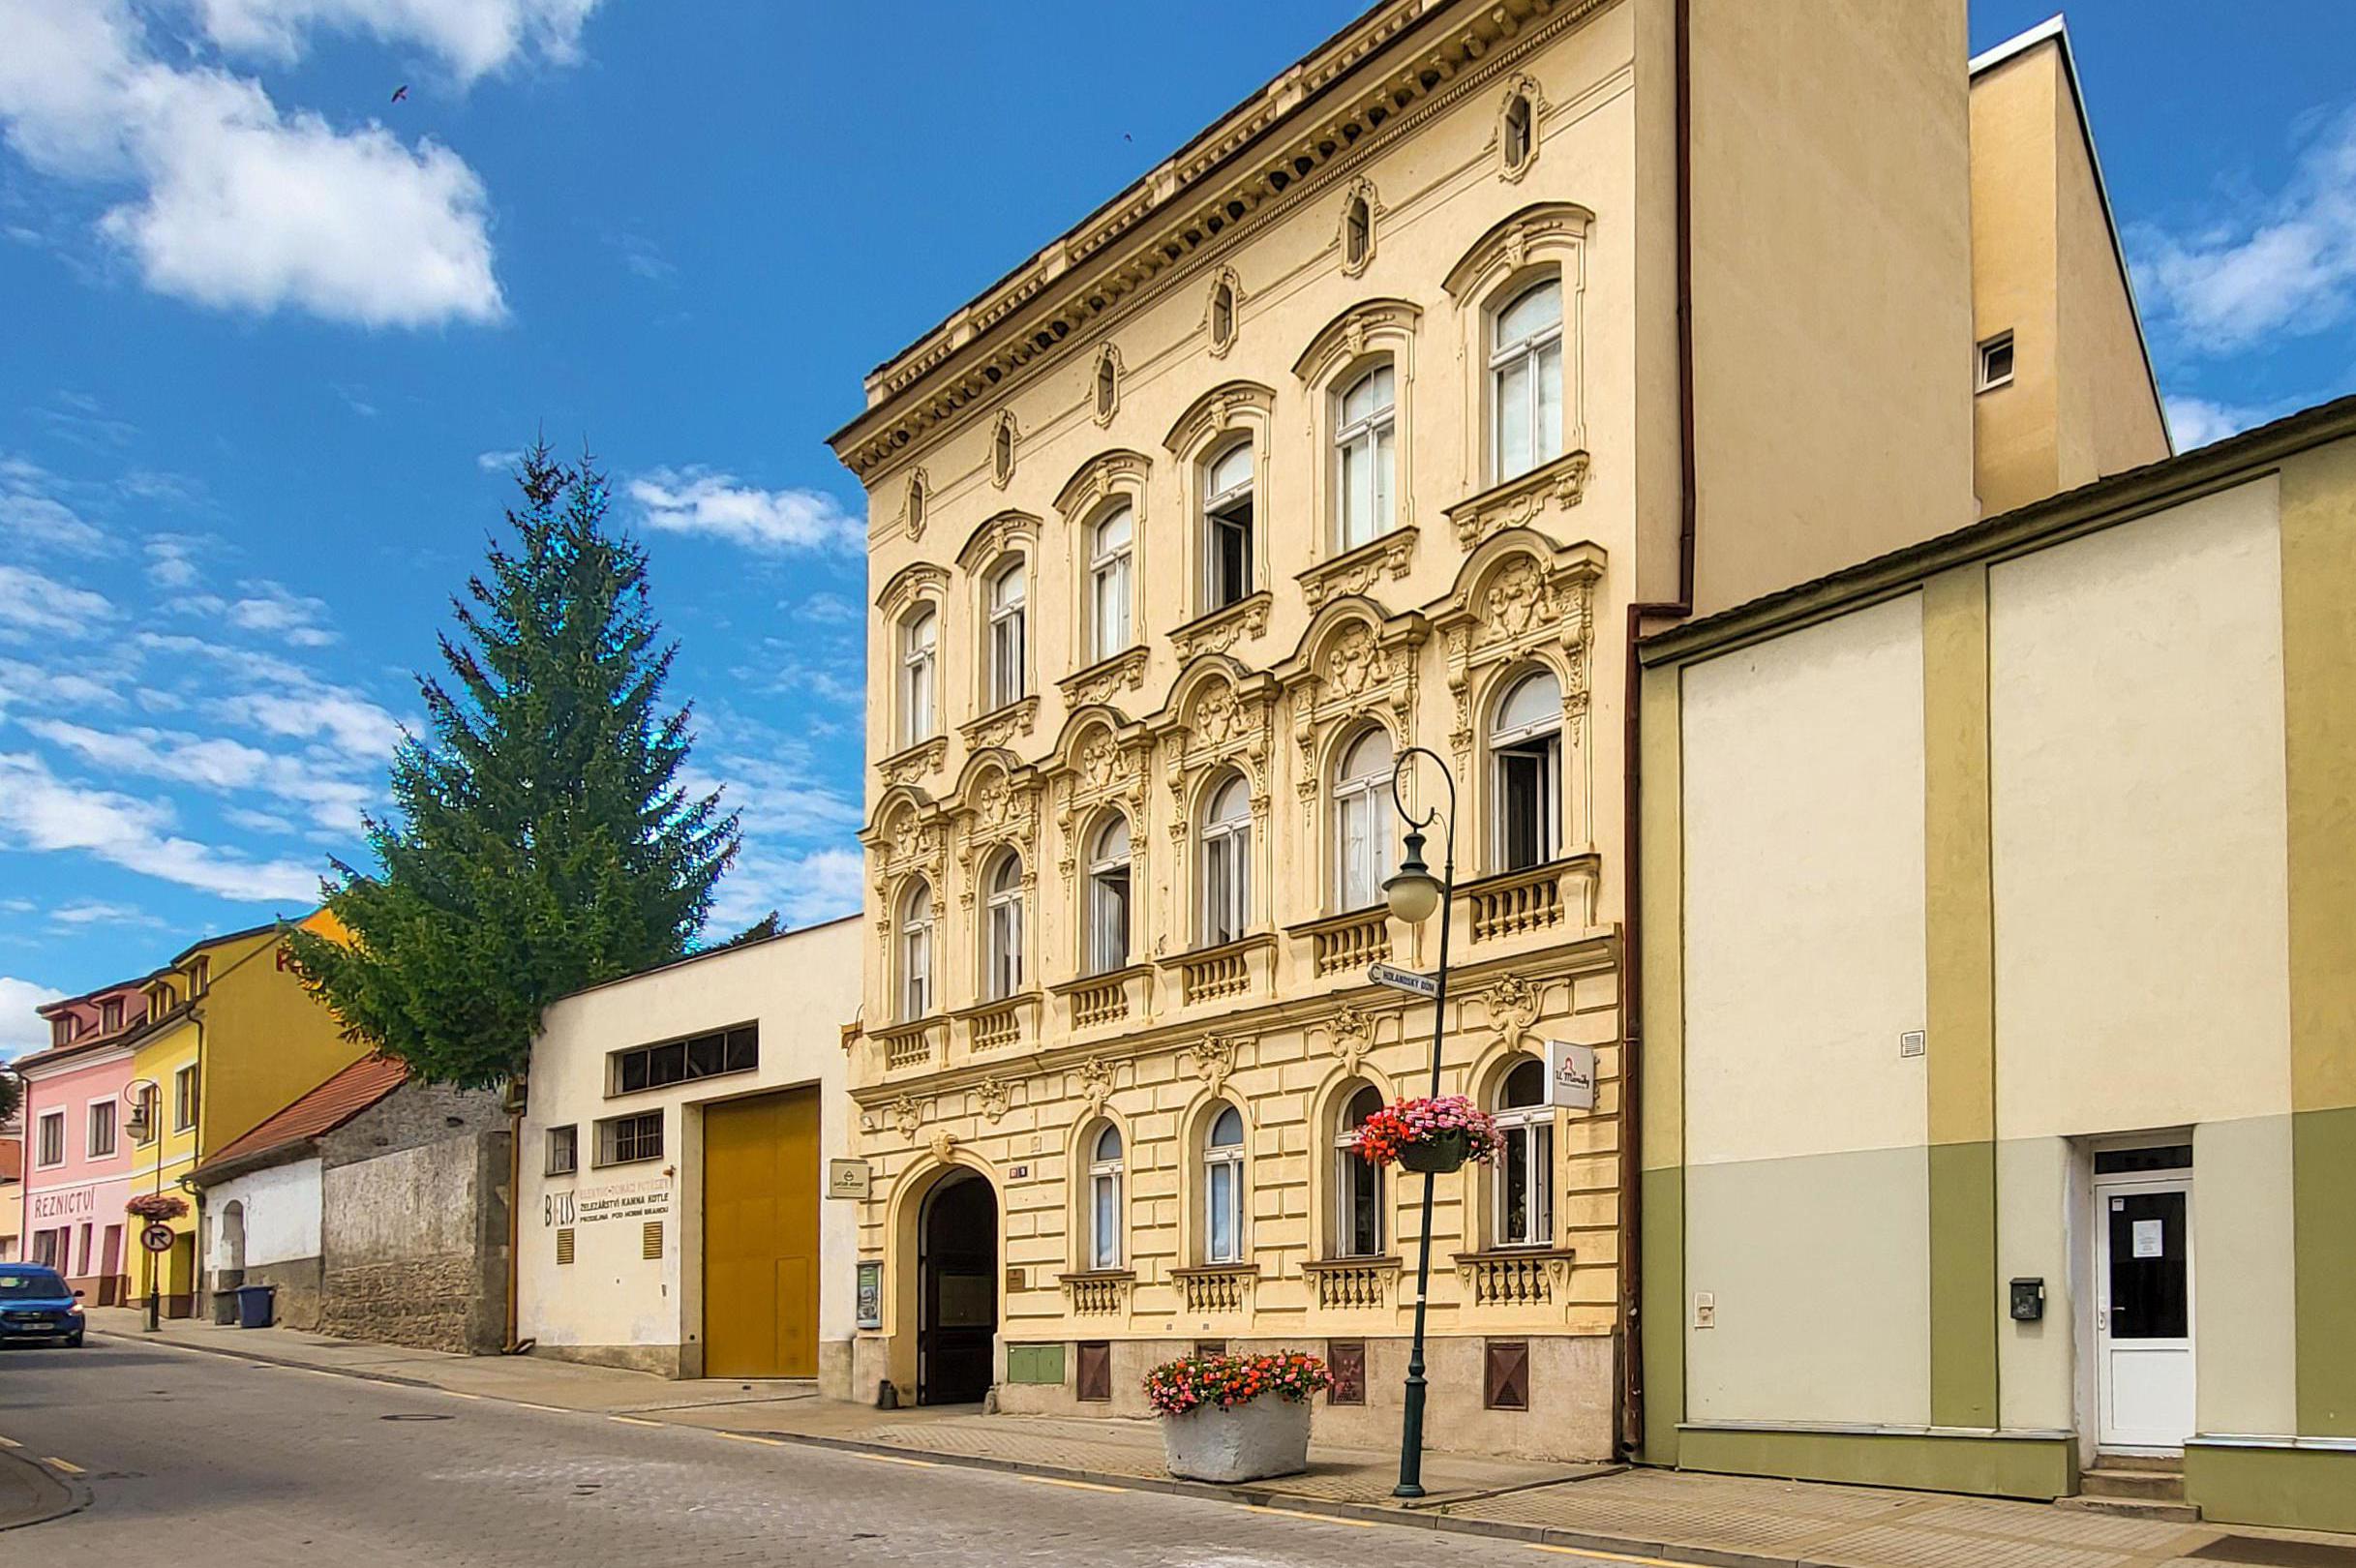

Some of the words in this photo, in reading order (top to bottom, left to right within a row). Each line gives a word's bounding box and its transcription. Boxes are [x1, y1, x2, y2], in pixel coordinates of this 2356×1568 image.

[35, 1186, 95, 1218] ŘEZNICTVÍ
[621, 1195, 645, 1207] KAMNA
[648, 1191, 669, 1204] KOTLE
